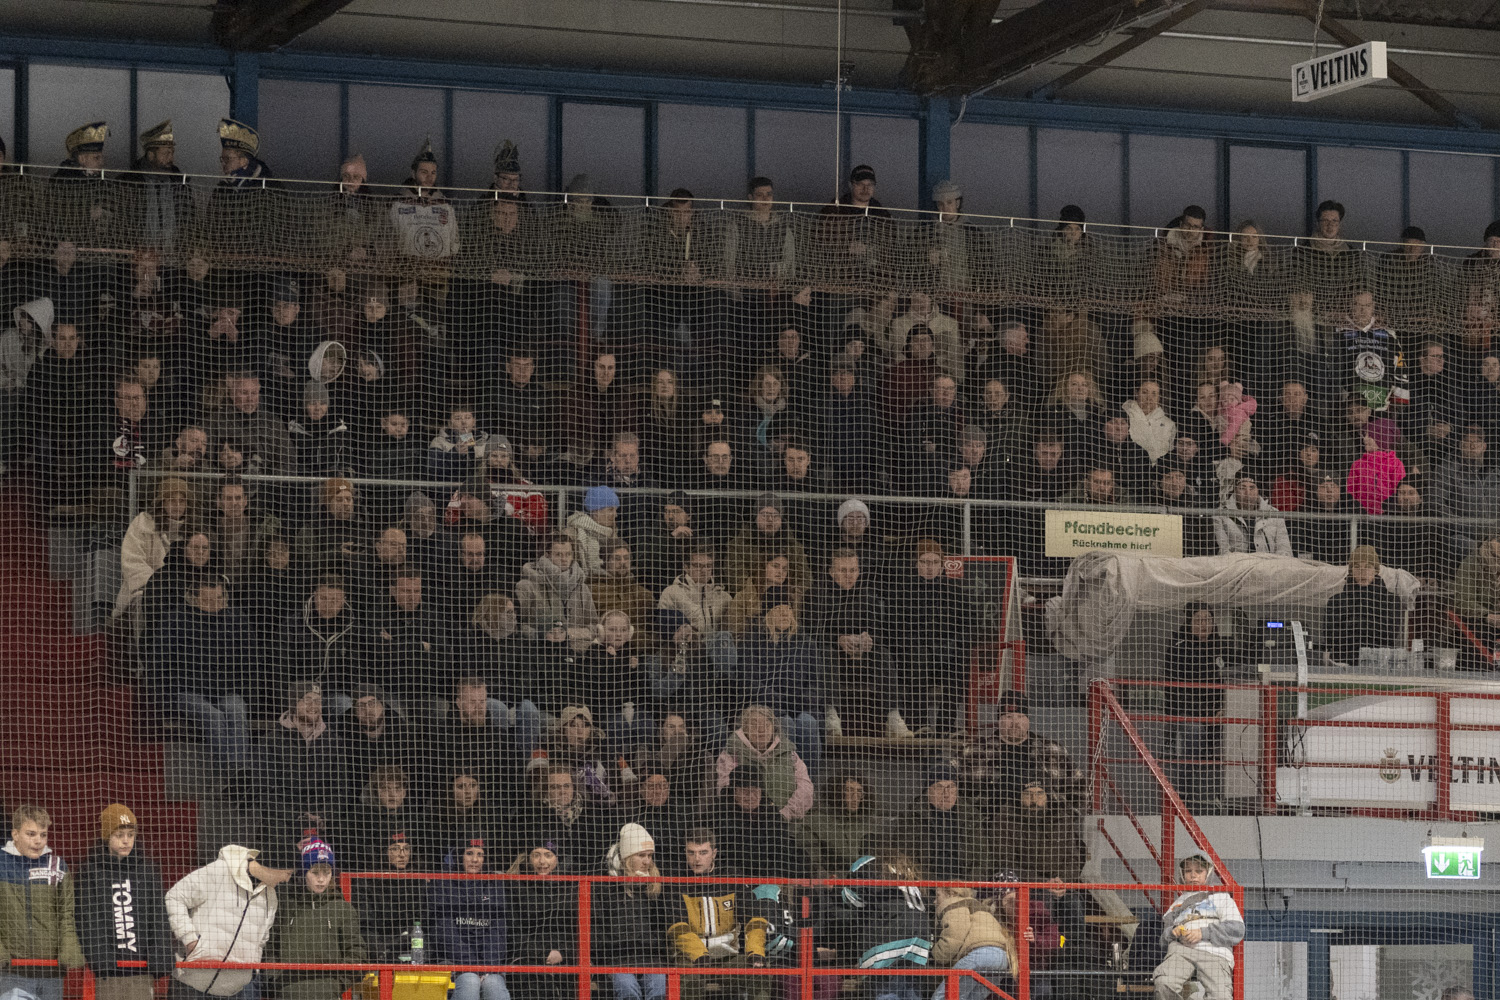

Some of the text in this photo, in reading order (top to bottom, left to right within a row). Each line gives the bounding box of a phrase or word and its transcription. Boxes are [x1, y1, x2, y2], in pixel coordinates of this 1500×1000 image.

[1310, 48, 1368, 90] VELTINS
[1064, 521, 1160, 538] Pfandbecher
[1072, 539, 1152, 550] Rücknahme hier!
[112, 879, 138, 953] TOMMY
